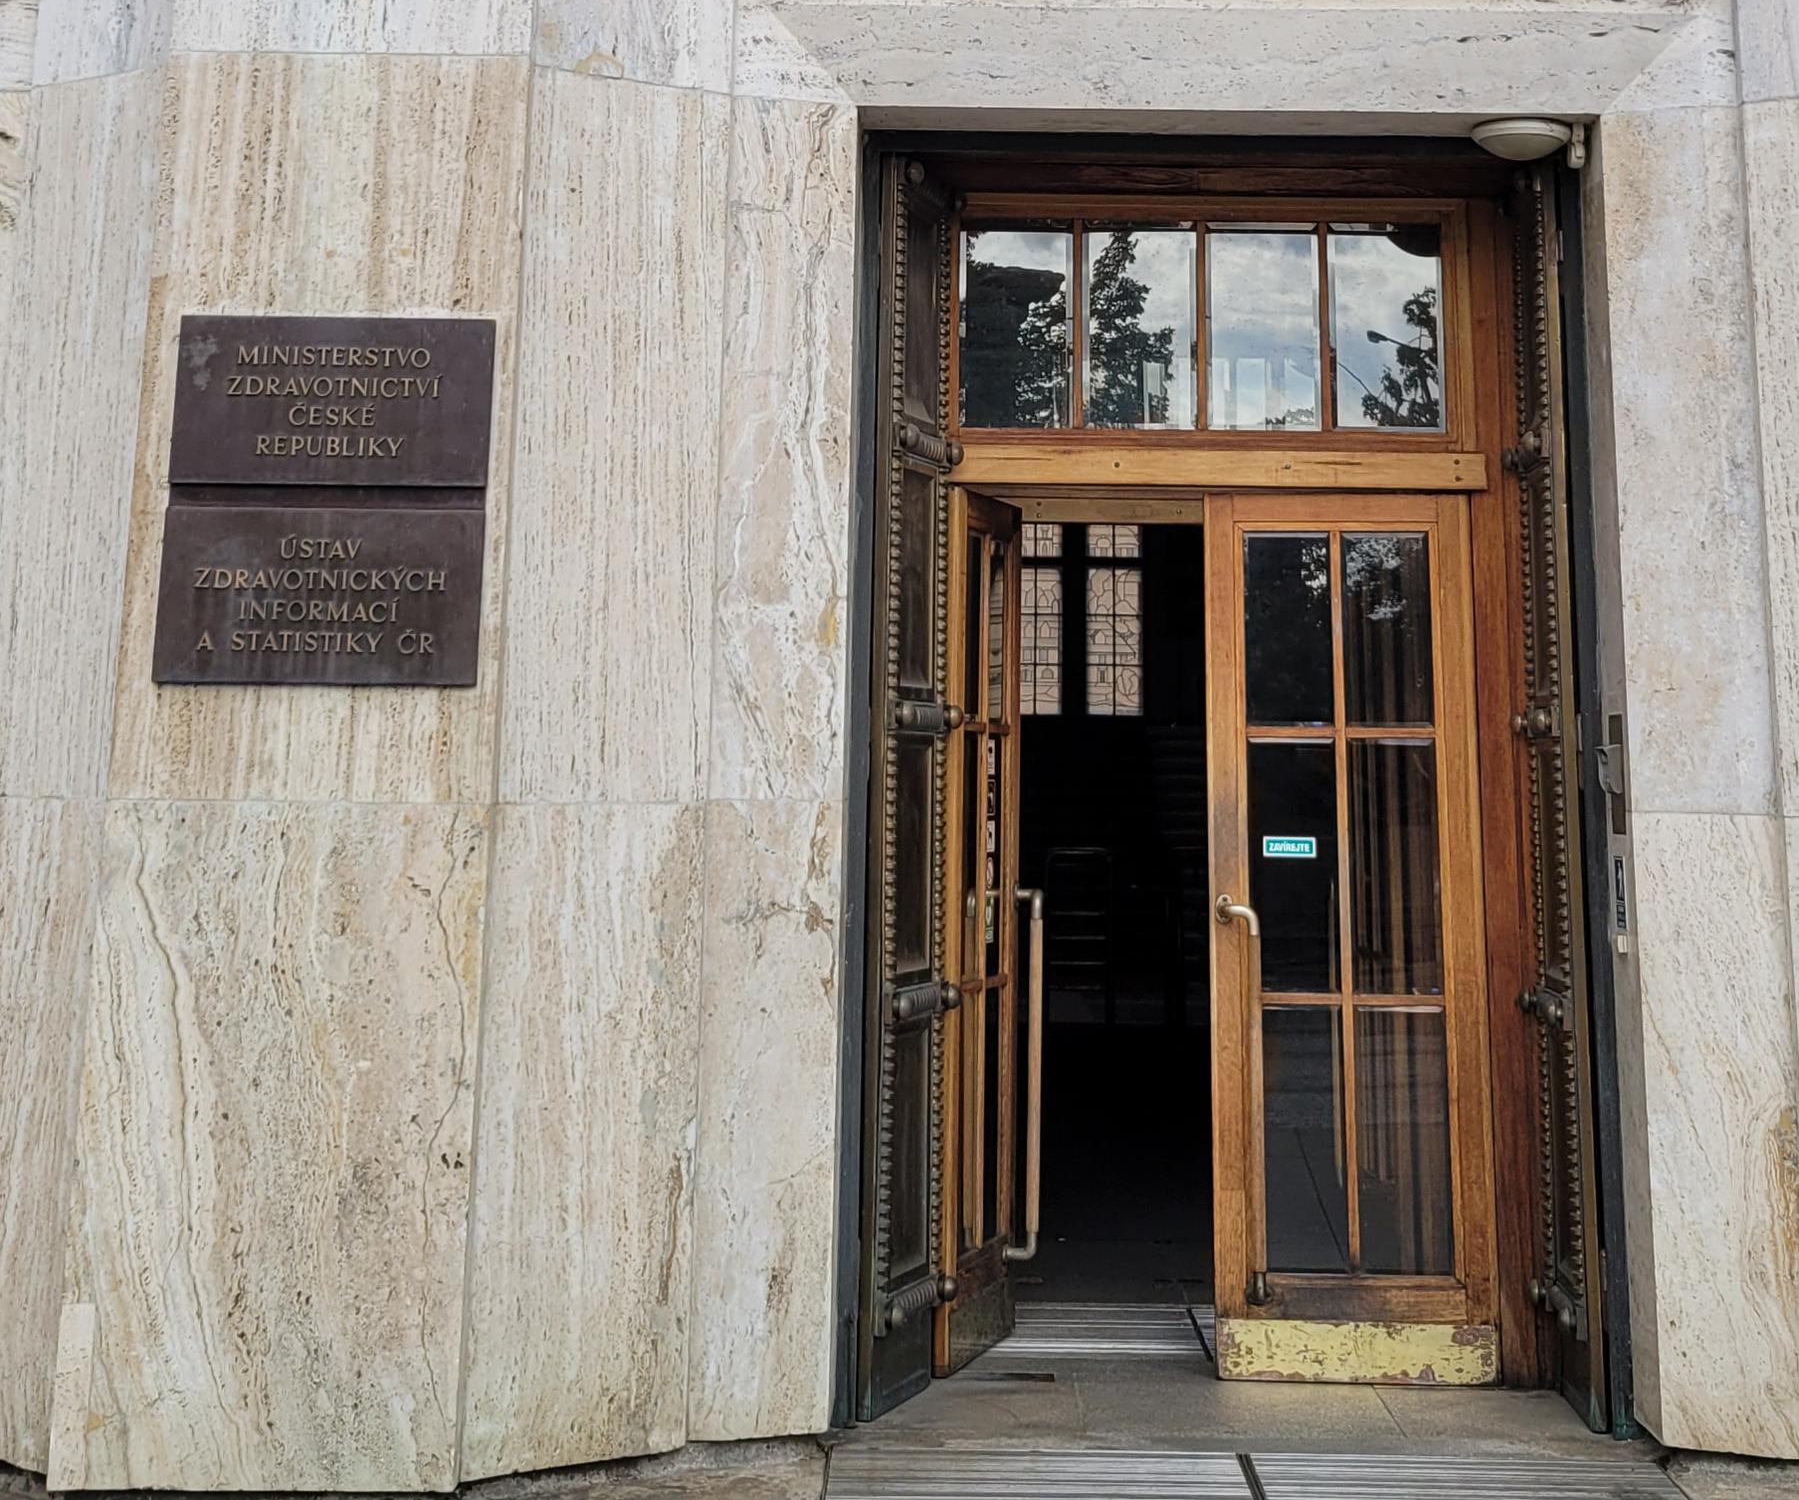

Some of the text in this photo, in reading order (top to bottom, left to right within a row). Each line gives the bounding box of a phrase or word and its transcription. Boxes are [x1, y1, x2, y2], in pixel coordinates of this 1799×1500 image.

[237, 345, 431, 368] MINISTERSTVO
[226, 373, 443, 398] ZDRAVOTNICTVÍ
[288, 403, 377, 427] ČESKÉ
[255, 435, 404, 457] REPUBLIKY
[279, 534, 362, 561] ÚSTAV
[193, 566, 448, 592] ZDRAVOTNICKÝCH
[239, 597, 400, 623] INFORMACÍ
[197, 629, 436, 655] A STATISTIKY ČR
